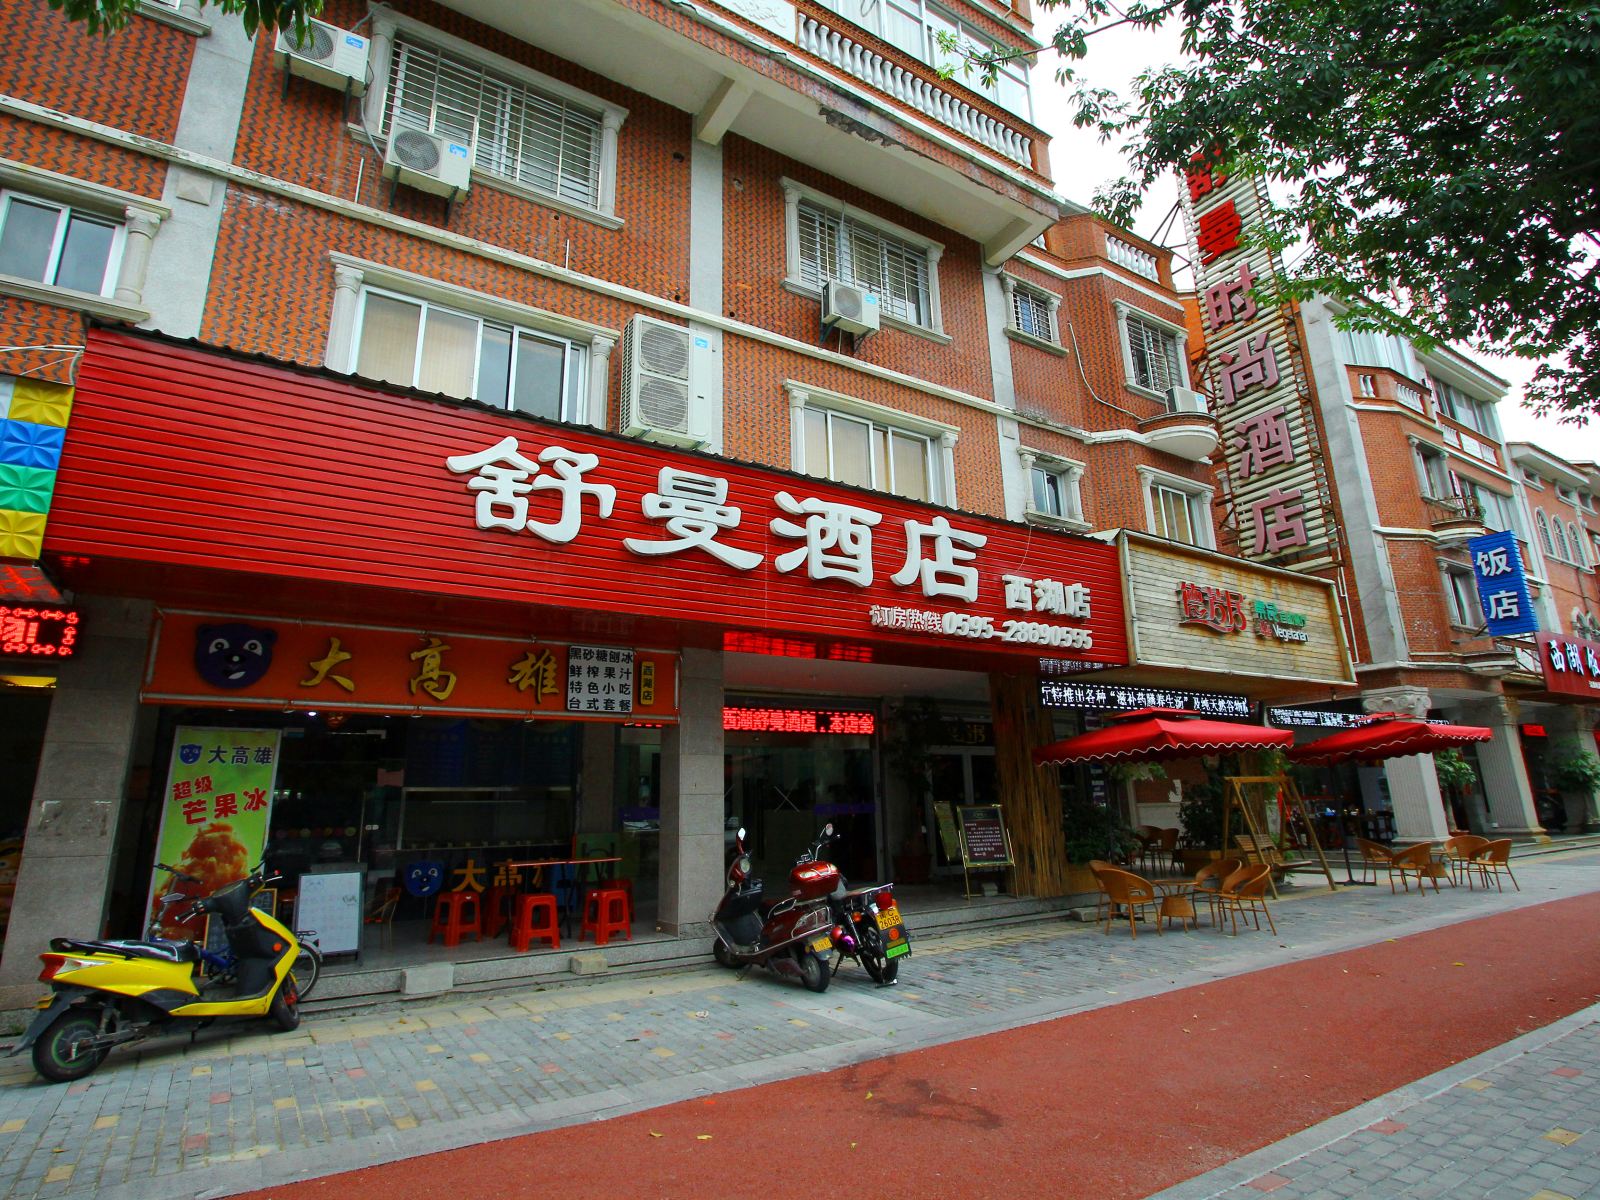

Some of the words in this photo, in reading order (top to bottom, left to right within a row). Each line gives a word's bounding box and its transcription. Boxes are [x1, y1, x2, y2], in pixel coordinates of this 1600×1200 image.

[446, 435, 988, 603] 舒曼酒店
[1476, 546, 1519, 620] 饭店
[1001, 573, 1092, 621] 西湖店
[870, 604, 942, 632] 订房热线
[570, 647, 633, 664] 黑砂糖刨冰
[300, 636, 561, 703] 大高雄
[569, 664, 632, 681] 鲜榨果汁
[569, 680, 631, 696] 特色小吃
[569, 696, 631, 712] 台式套餐
[208, 745, 273, 765] 大高雄
[173, 775, 213, 801] 超级
[182, 787, 268, 825] 芒果冰
